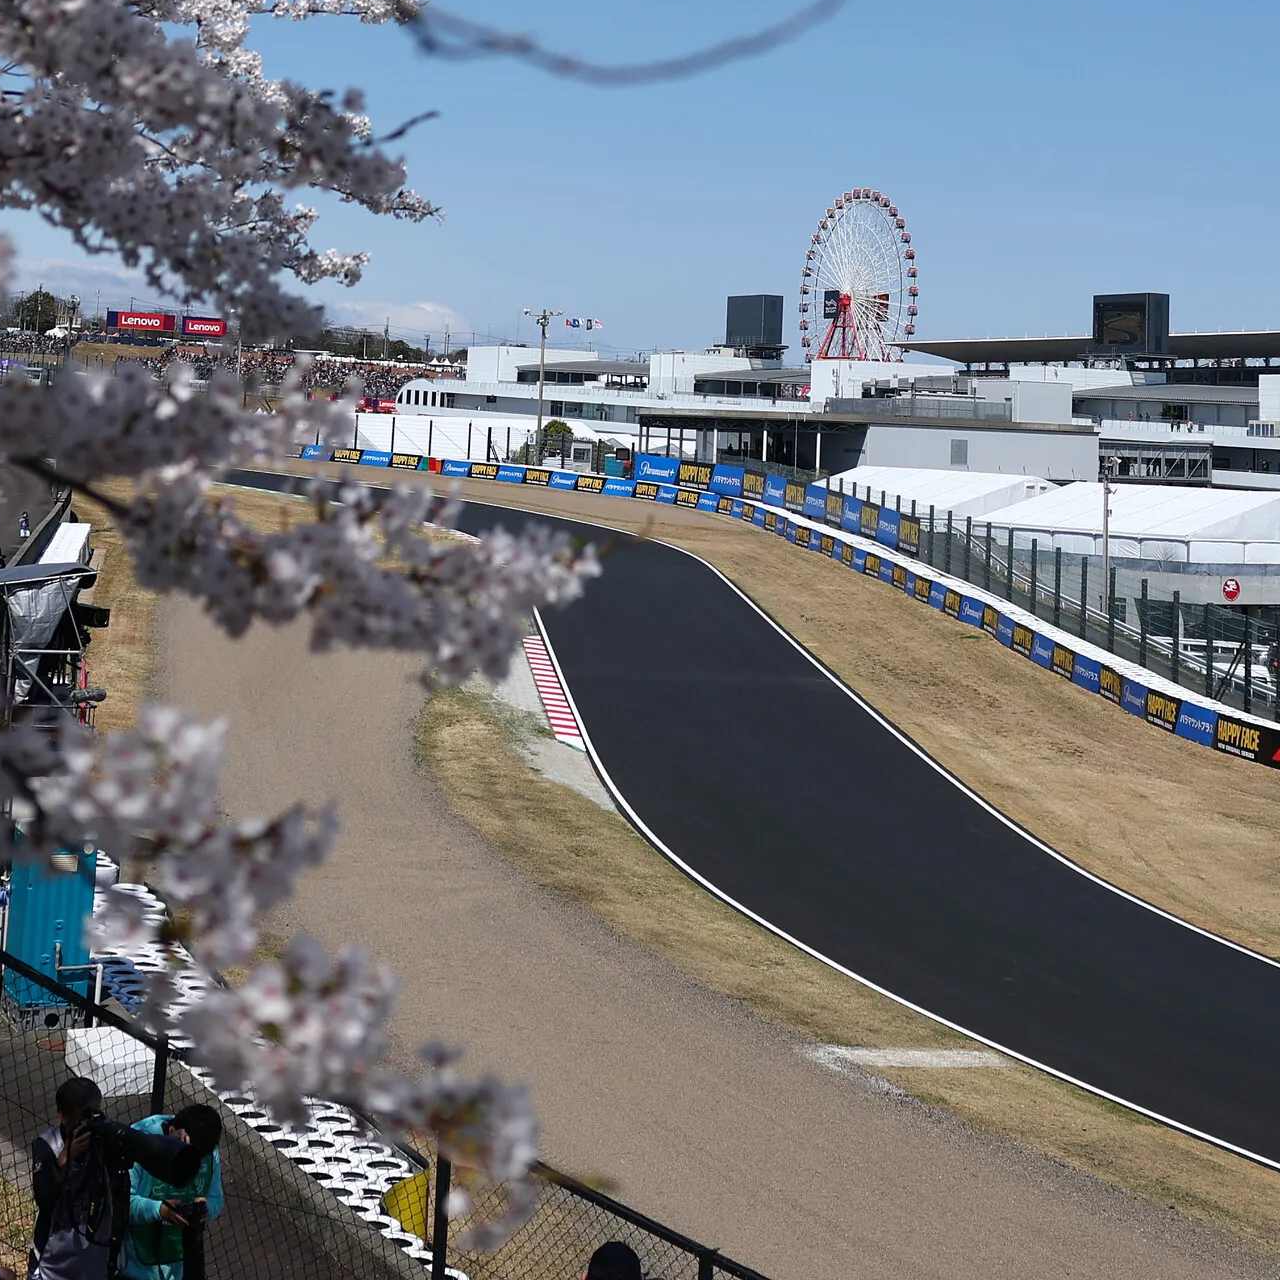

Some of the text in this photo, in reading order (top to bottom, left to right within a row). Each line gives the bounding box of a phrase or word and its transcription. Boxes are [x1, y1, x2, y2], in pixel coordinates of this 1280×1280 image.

[122, 316, 160, 326] Lenovo
[188, 322, 220, 332] Lenovo
[530, 434, 534, 443] 5
[334, 449, 360, 460] HAPPY FACE
[392, 454, 407, 464] HAPPY
[407, 456, 418, 466] FACE
[472, 464, 497, 476] HAPPY FACE
[639, 461, 674, 478] Paramount+
[680, 464, 710, 484] HAPPY FACE
[526, 470, 549, 482] HAPPY FACE
[552, 474, 575, 485] Paramount+
[714, 476, 740, 486] パラマウントプラス
[578, 477, 592, 488] HAPPY
[592, 478, 603, 490] FACE
[636, 484, 648, 495] HAPPY
[1124, 685, 1145, 707] Paramount+
[1148, 694, 1164, 718] HAPPY
[1164, 700, 1177, 722] FACE
[1180, 714, 1214, 734] パラマウントプラス
[1218, 719, 1260, 751] HAPPY FACE
[1241, 750, 1254, 759] SERIES
